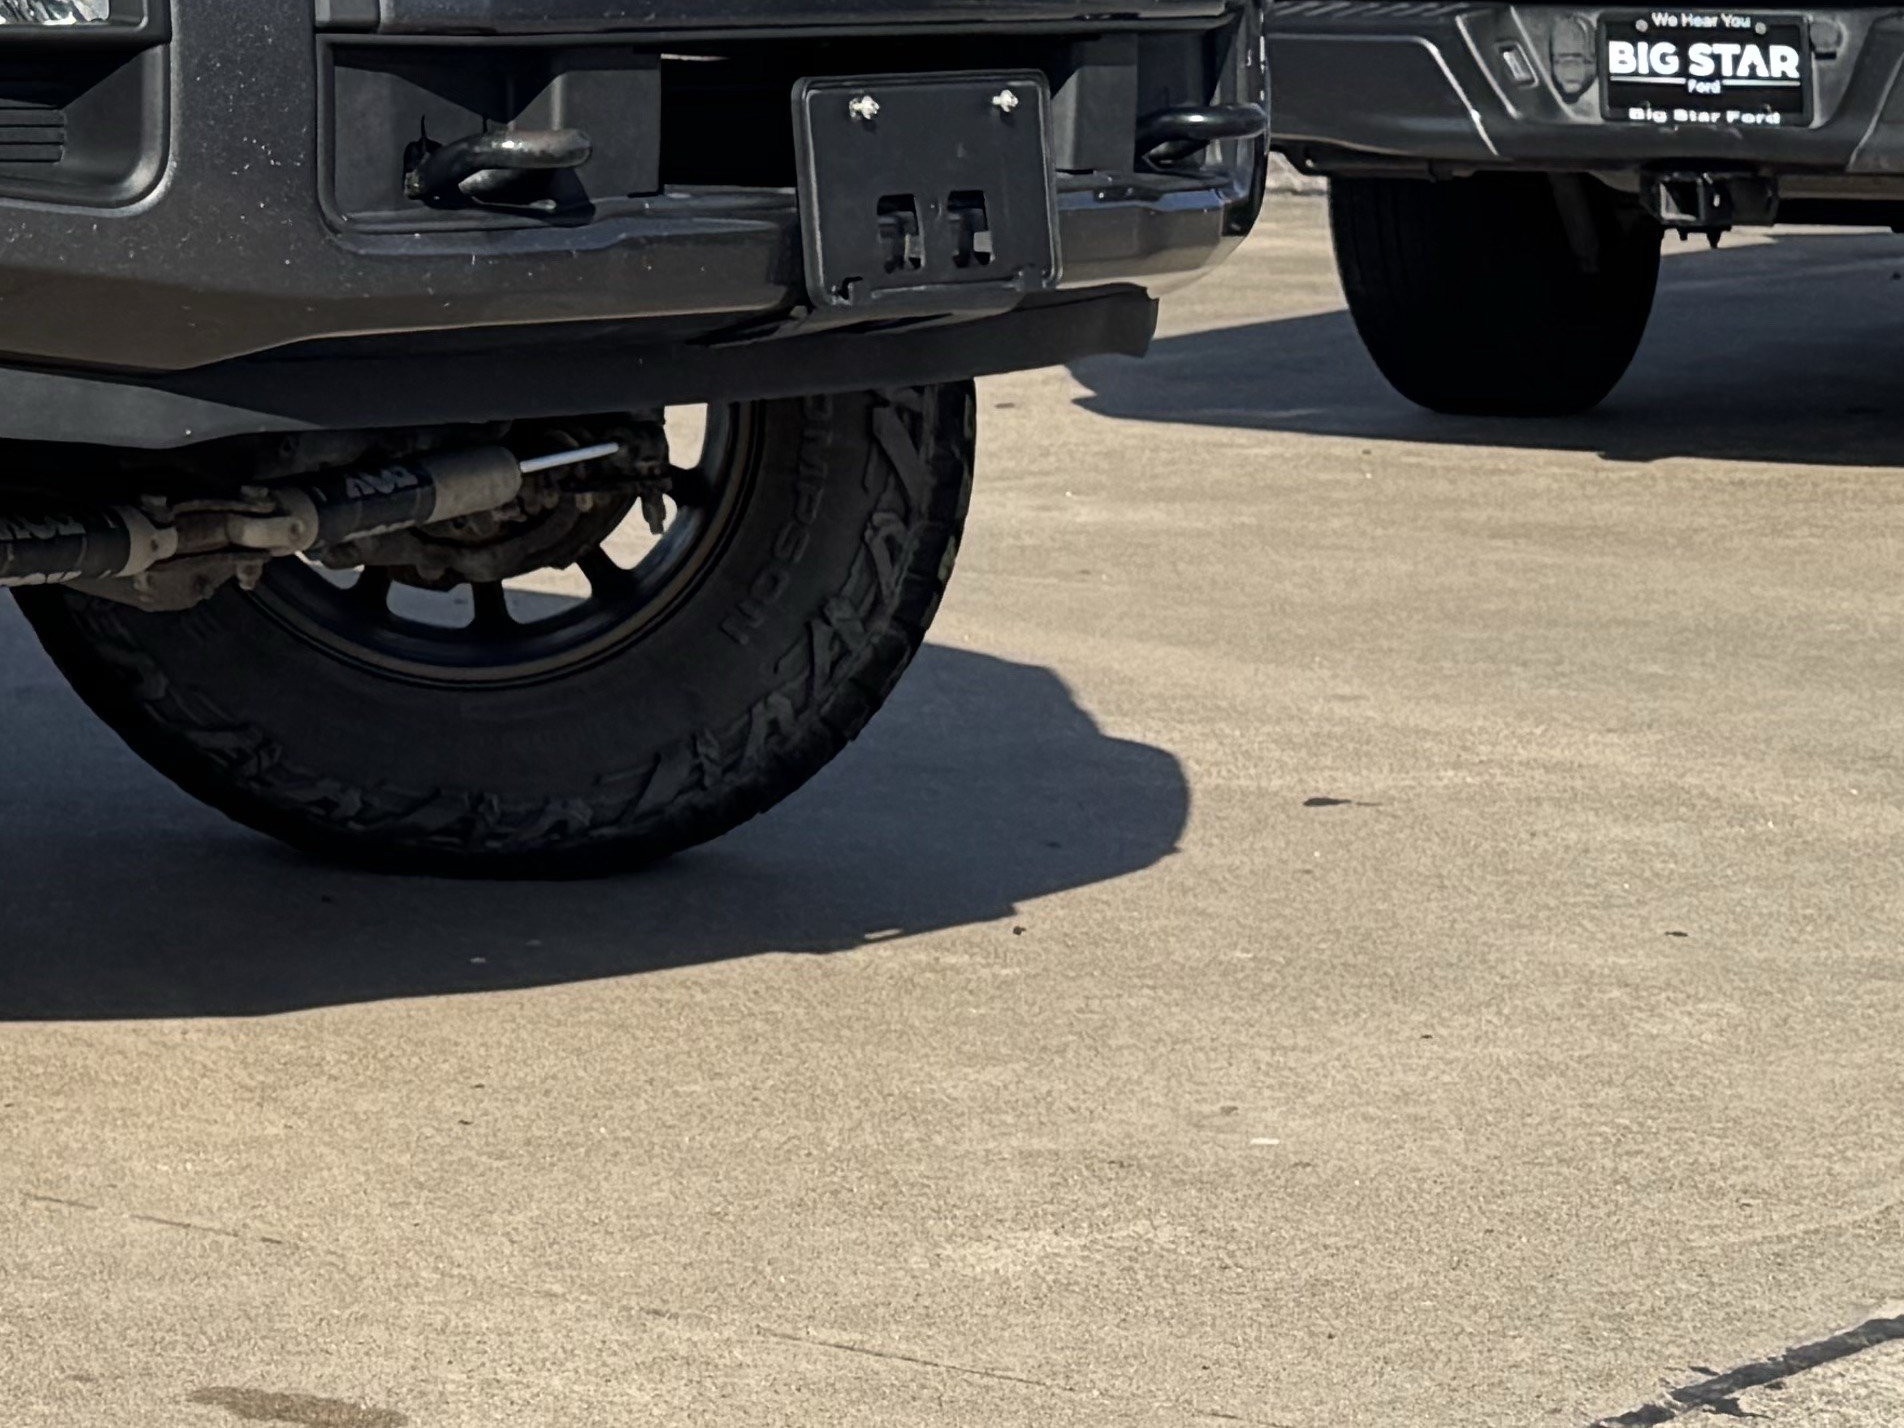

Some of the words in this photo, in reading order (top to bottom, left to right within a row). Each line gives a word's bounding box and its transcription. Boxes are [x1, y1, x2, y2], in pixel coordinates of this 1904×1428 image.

[1651, 12, 1678, 27] We
[1681, 12, 1718, 28] Hear
[1721, 13, 1752, 28] You
[1608, 40, 1680, 75] BIG
[1688, 42, 1800, 78] STAR
[1687, 78, 1722, 94] Ford
[1628, 106, 1668, 124] Big
[1673, 107, 1721, 123] Star
[1726, 109, 1781, 125] Ford
